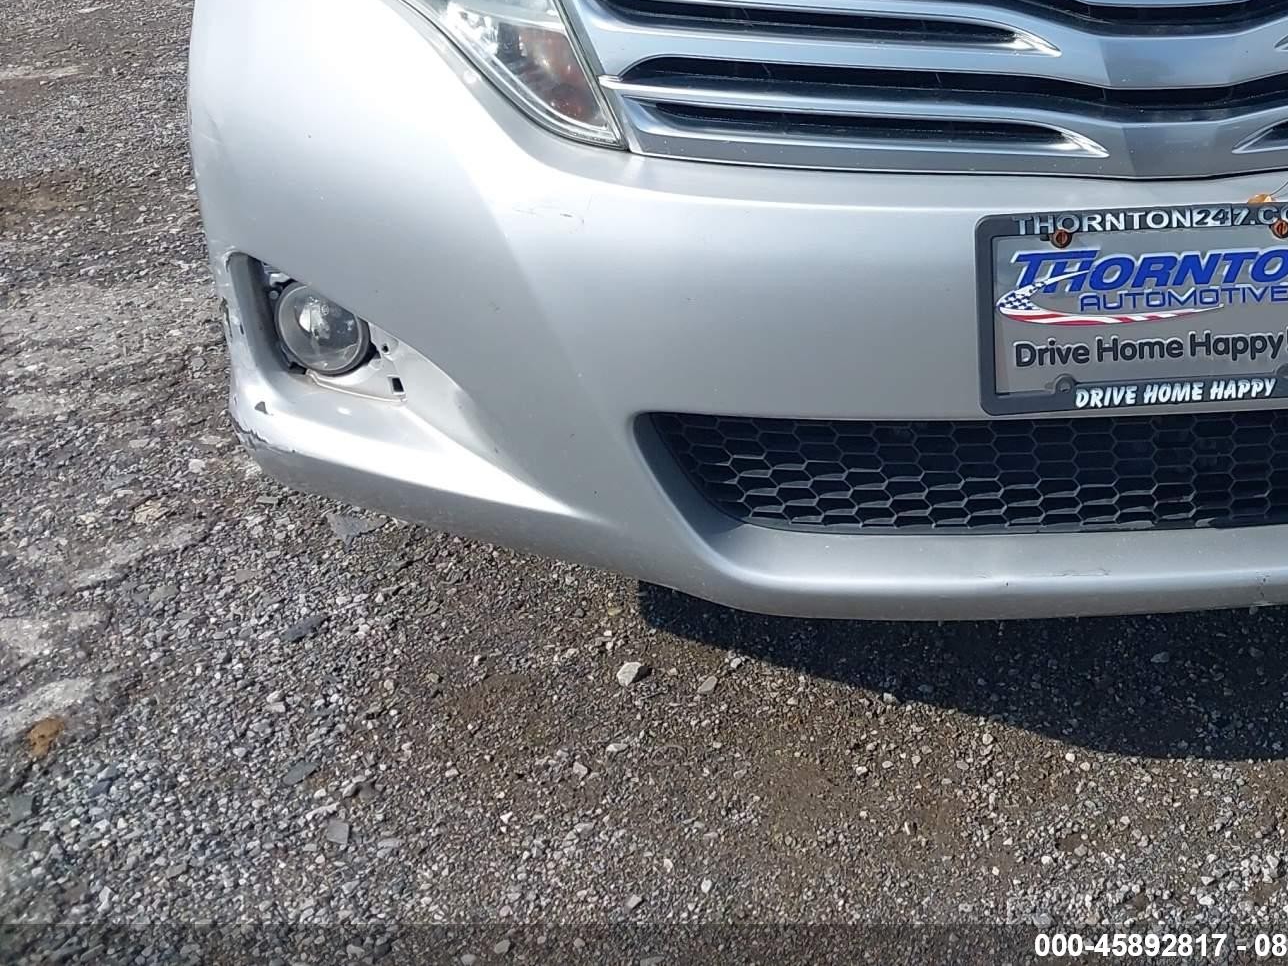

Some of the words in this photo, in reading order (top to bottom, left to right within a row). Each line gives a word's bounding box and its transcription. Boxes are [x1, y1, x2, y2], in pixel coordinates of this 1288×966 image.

[1013, 337, 1090, 368] Drive
[1096, 335, 1184, 363] Home
[1074, 385, 1137, 409] DRIVE
[1143, 382, 1203, 404] HOME
[1209, 377, 1277, 401] HAPPY
